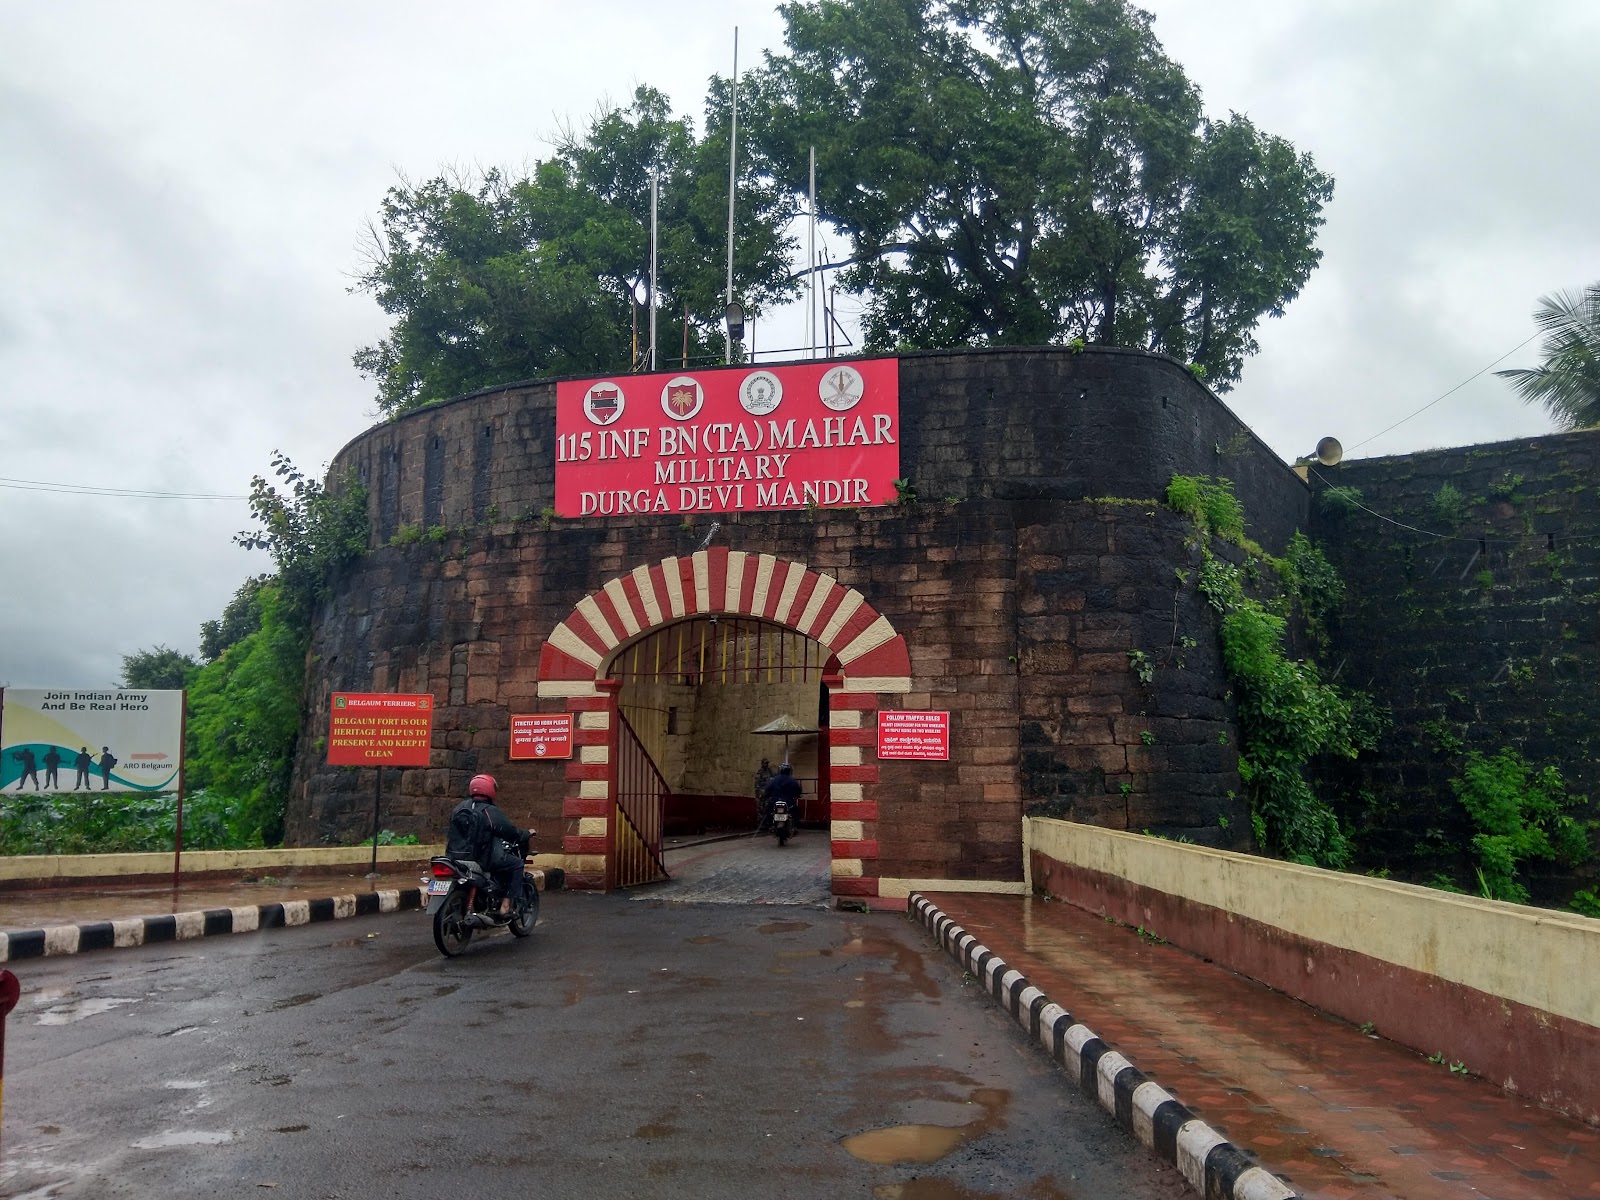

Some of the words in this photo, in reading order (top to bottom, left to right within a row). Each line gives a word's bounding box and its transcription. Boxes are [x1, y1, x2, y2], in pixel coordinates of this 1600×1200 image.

[557, 431, 592, 462] 115
[598, 428, 650, 460] INF
[654, 453, 791, 485] MILITARY
[580, 488, 670, 515] DURGA
[678, 484, 744, 511] DEVI
[755, 478, 871, 507] MANDIR
[44, 692, 70, 700] Join
[74, 692, 112, 701] Indian
[115, 692, 147, 703] Army
[41, 702, 65, 711] And
[69, 702, 86, 711] Be
[90, 702, 116, 711] Real
[120, 703, 149, 711] Hero
[334, 717, 375, 725] BELGAUM
[409, 718, 428, 726] OUR
[334, 728, 377, 736] HERITAGE
[415, 729, 427, 737] TO
[332, 739, 375, 747] PRESERVE
[376, 739, 394, 747] AND
[365, 750, 393, 758] CLEAN
[141, 762, 173, 771] Belgaum
